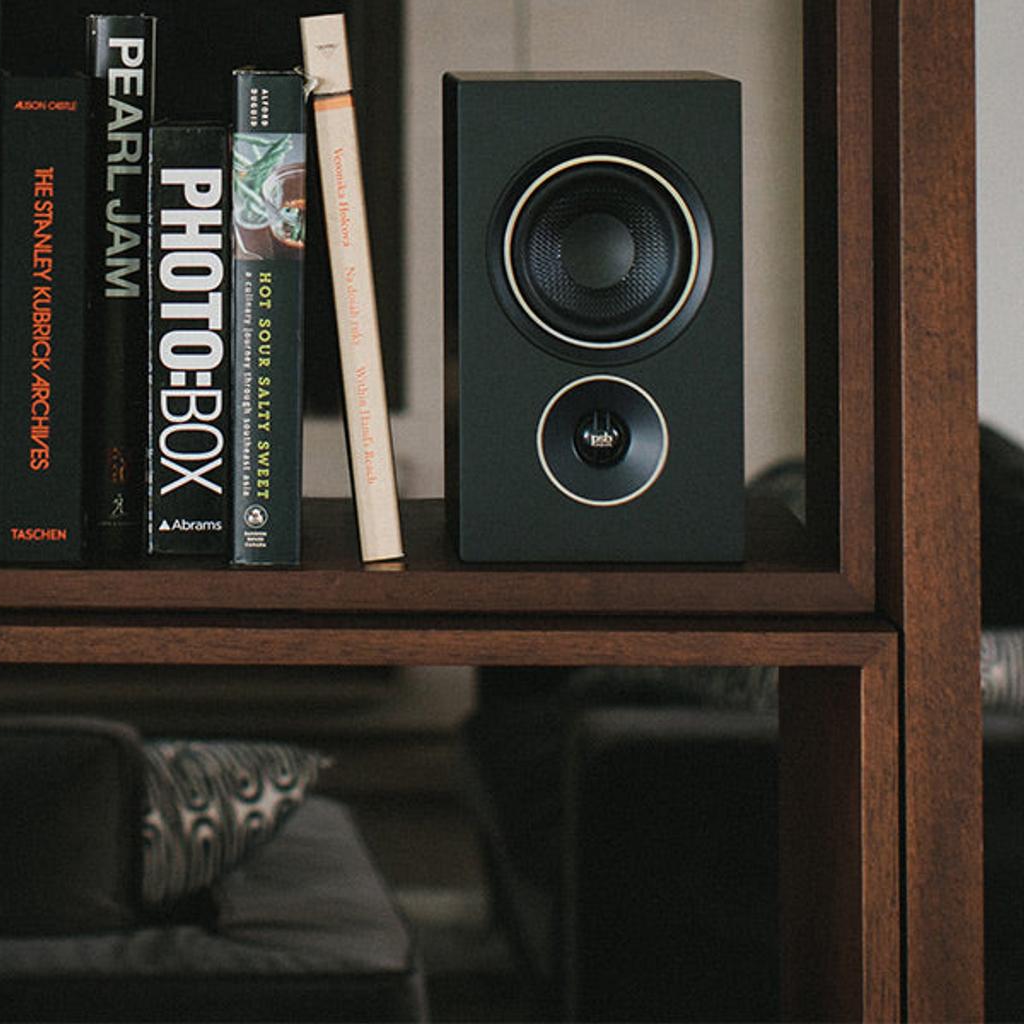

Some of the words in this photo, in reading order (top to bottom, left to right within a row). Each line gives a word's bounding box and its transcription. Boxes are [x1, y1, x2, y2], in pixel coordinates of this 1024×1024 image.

[106, 37, 145, 193] PEARL
[33, 166, 55, 197] THE
[31, 199, 54, 282] STANLEY
[104, 198, 142, 298] JAM
[243, 281, 253, 325] culinary
[259, 272, 272, 310] HOT
[30, 286, 53, 372] KUBRICK
[243, 327, 253, 368] journey
[258, 318, 272, 368] SOUR
[242, 372, 253, 414] through
[257, 376, 271, 432] SALTY
[29, 372, 52, 472] ARCHIVES
[242, 417, 252, 471] southeast
[242, 474, 251, 497] asia
[256, 440, 271, 500] SWEET
[10, 528, 67, 541] TASCHEN
[172, 519, 223, 530] Abrams
